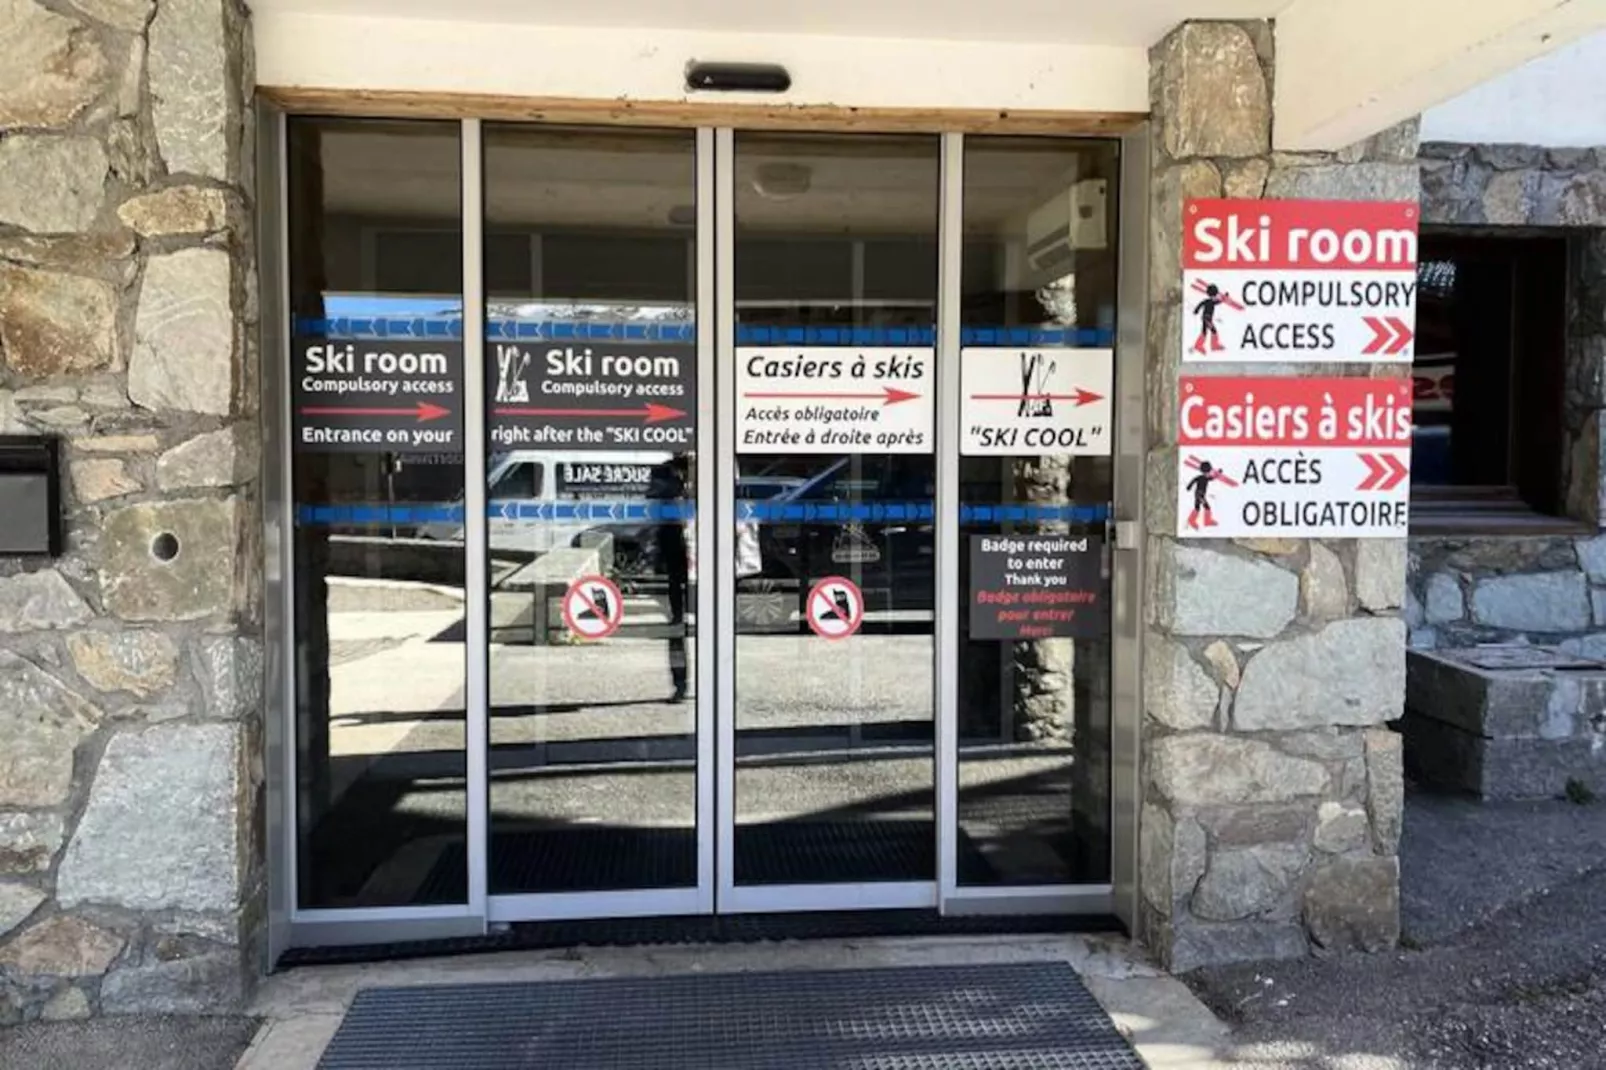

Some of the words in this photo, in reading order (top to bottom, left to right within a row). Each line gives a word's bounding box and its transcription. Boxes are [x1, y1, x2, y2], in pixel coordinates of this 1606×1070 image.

[1194, 214, 1271, 262] Ski
[1288, 228, 1417, 263] room
[1242, 281, 1415, 308] COMPULSORY
[1240, 323, 1335, 350] ACCESS
[306, 344, 354, 373] Ski
[364, 352, 448, 374] room
[546, 348, 592, 376] Ski
[602, 355, 680, 377] room
[747, 355, 842, 378] Casiers
[851, 354, 866, 378] à
[873, 355, 924, 379] skis
[302, 376, 399, 395] Compulsory
[402, 379, 454, 393] access
[541, 380, 633, 397] Compulsory
[635, 383, 684, 396] access
[745, 407, 790, 421] Accès
[795, 406, 880, 423] obligatoire
[1181, 392, 1309, 440] Casiers
[1318, 392, 1337, 440] à
[1347, 393, 1412, 440] skis
[302, 427, 382, 443] Entrance
[386, 429, 409, 443] on
[412, 429, 454, 446] your
[491, 425, 530, 444] right
[534, 425, 573, 443] after
[577, 426, 603, 442] the
[606, 427, 639, 443] "SKI
[643, 427, 693, 443] COOL"
[743, 428, 800, 444] Entrée
[805, 428, 815, 444] à
[820, 428, 872, 444] droite
[876, 429, 924, 448] après
[971, 425, 1019, 447] "SKI
[1024, 425, 1102, 447] COOL"
[1243, 451, 1322, 485] ACCÈS
[1242, 501, 1406, 527] OBLIGATOIRE
[981, 538, 1025, 554] Badge
[1028, 538, 1088, 554] required
[1007, 558, 1023, 569] to
[1026, 558, 1064, 569] enter
[1005, 573, 1041, 585] Thank
[1044, 575, 1067, 587] you
